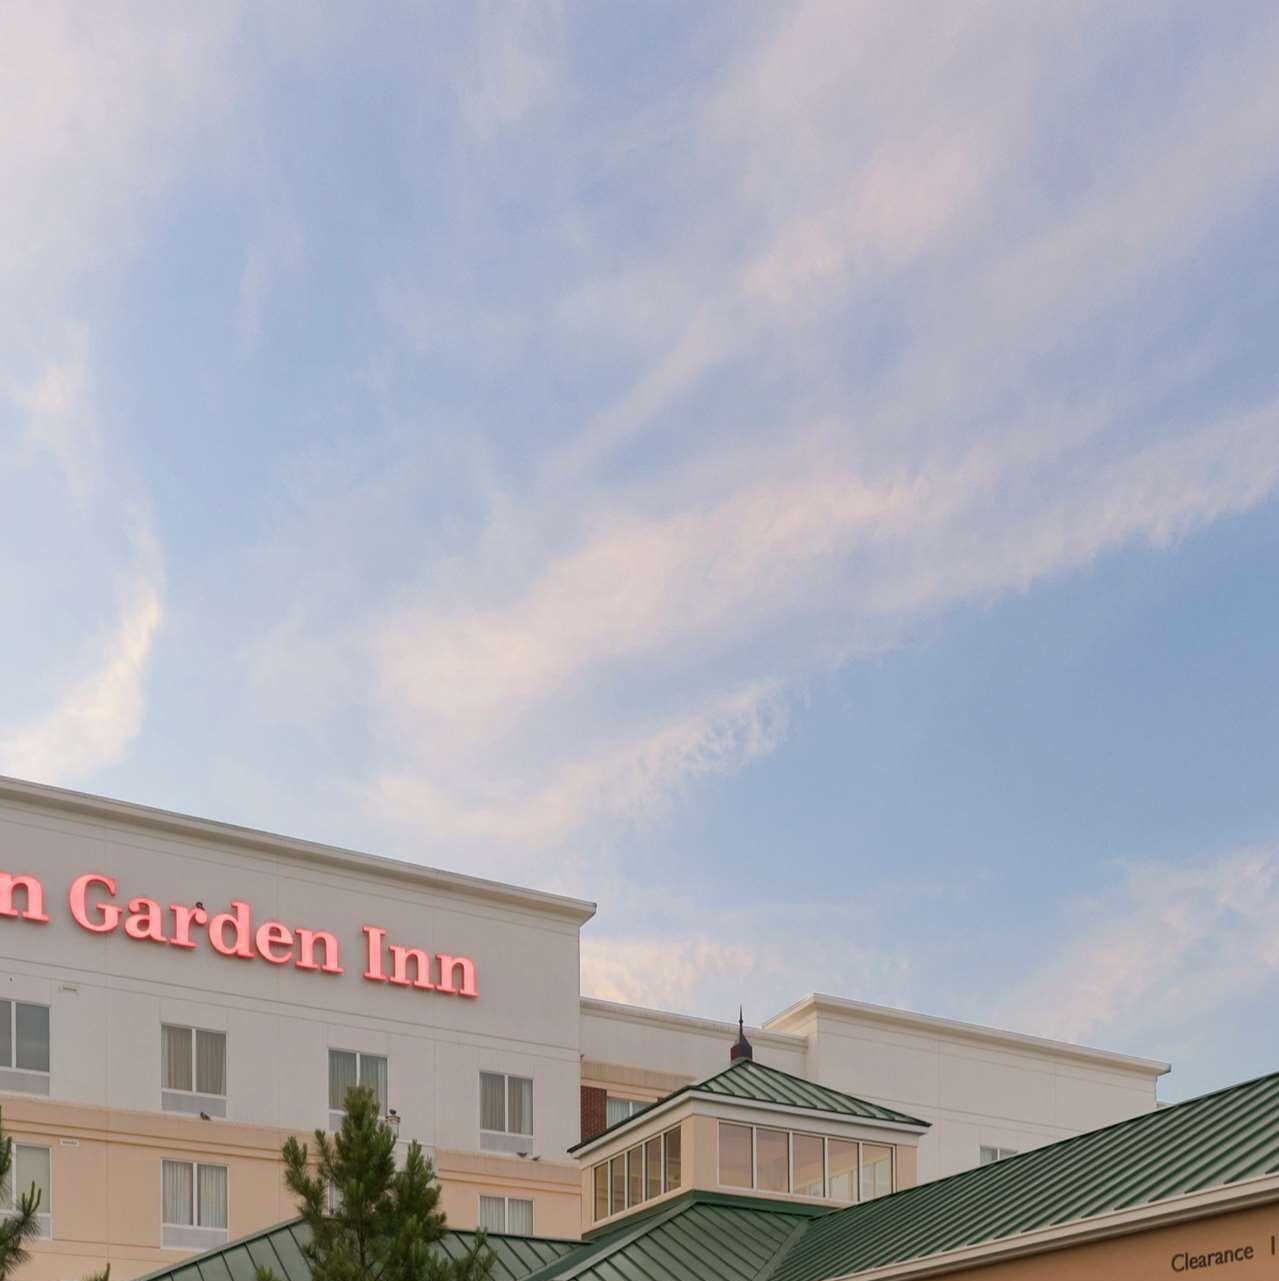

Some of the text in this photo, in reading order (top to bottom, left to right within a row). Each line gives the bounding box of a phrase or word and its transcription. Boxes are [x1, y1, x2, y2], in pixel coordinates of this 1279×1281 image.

[68, 873, 345, 974] Garden
[362, 924, 481, 998] Inn
[1171, 1246, 1255, 1272] Clearance
